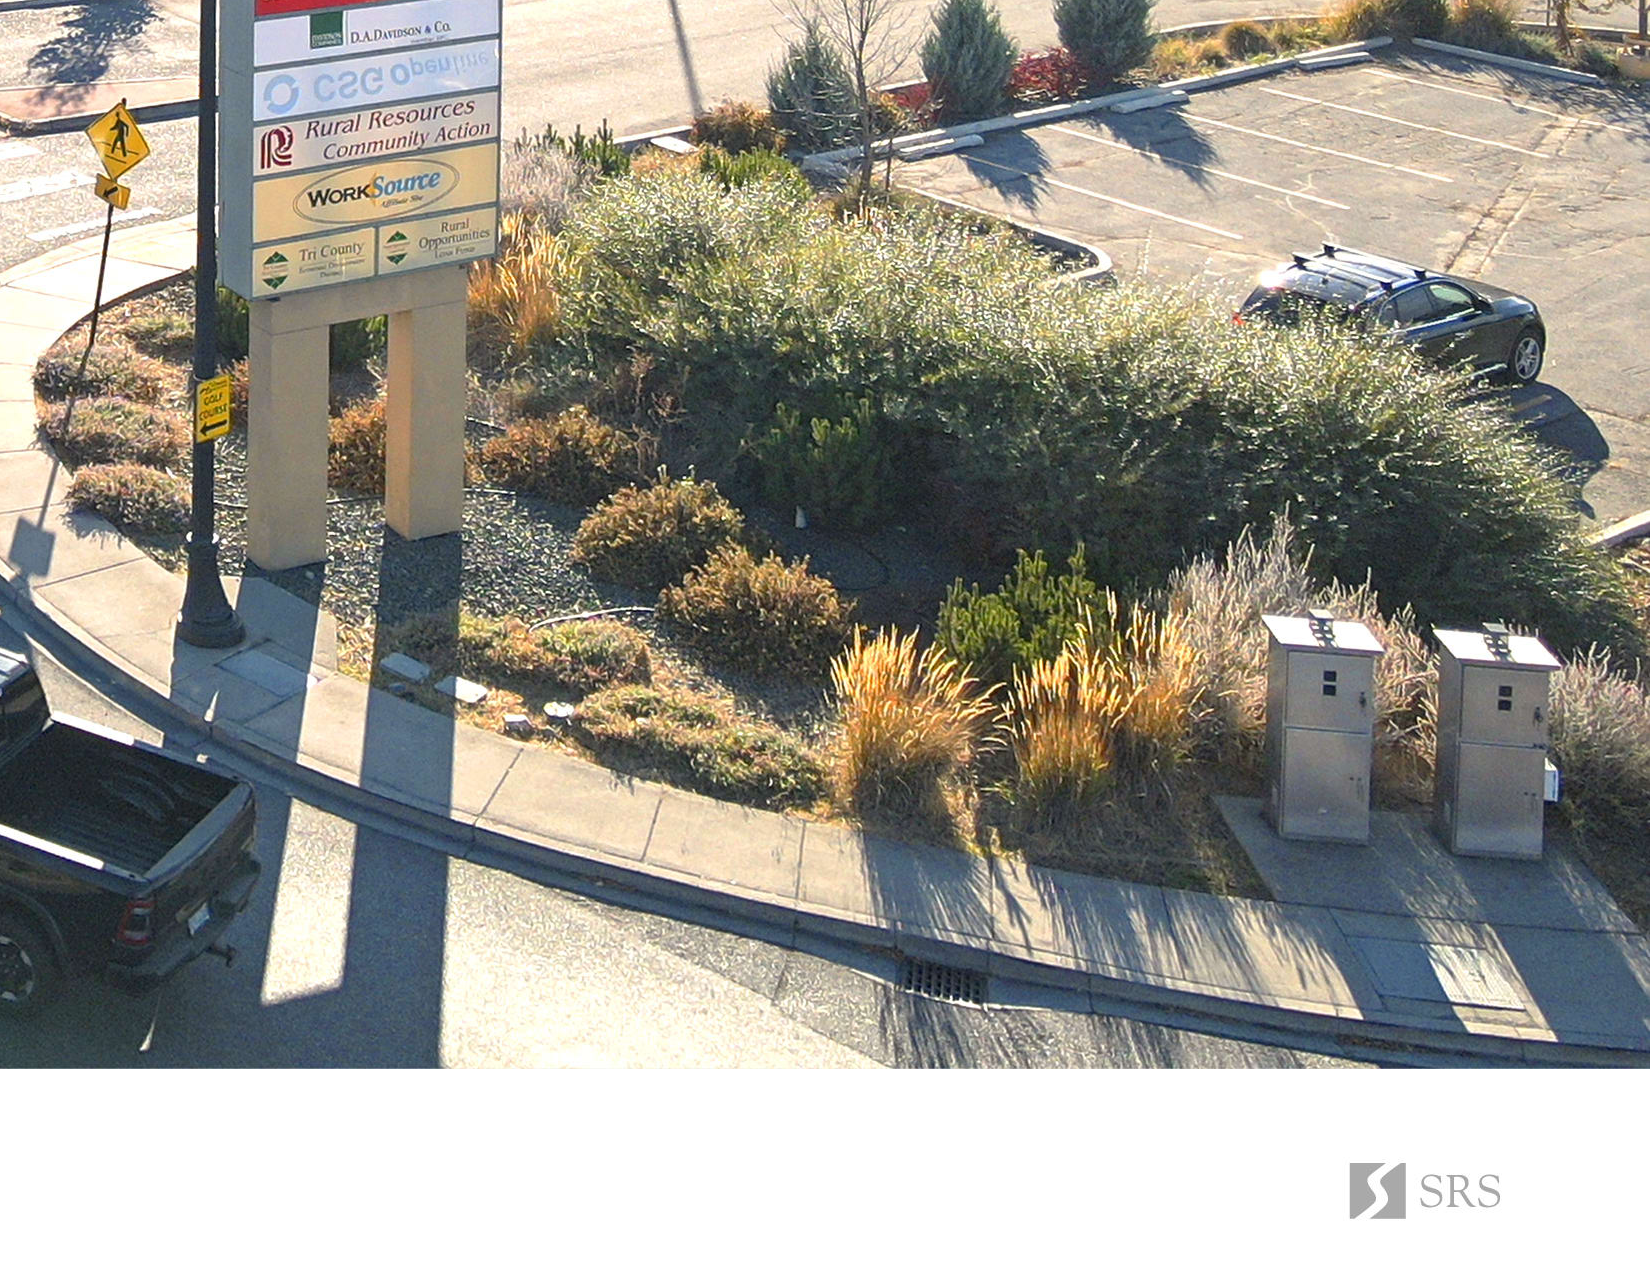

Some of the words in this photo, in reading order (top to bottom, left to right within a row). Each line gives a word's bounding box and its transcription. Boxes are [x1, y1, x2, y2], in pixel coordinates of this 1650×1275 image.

[304, 114, 362, 140] Rural
[367, 100, 475, 130] Resources
[323, 129, 429, 160] Community
[434, 119, 491, 143] Action
[441, 218, 470, 233] Rural
[418, 228, 490, 250] Opportunities
[299, 247, 317, 262] Tri
[320, 243, 364, 257] County
